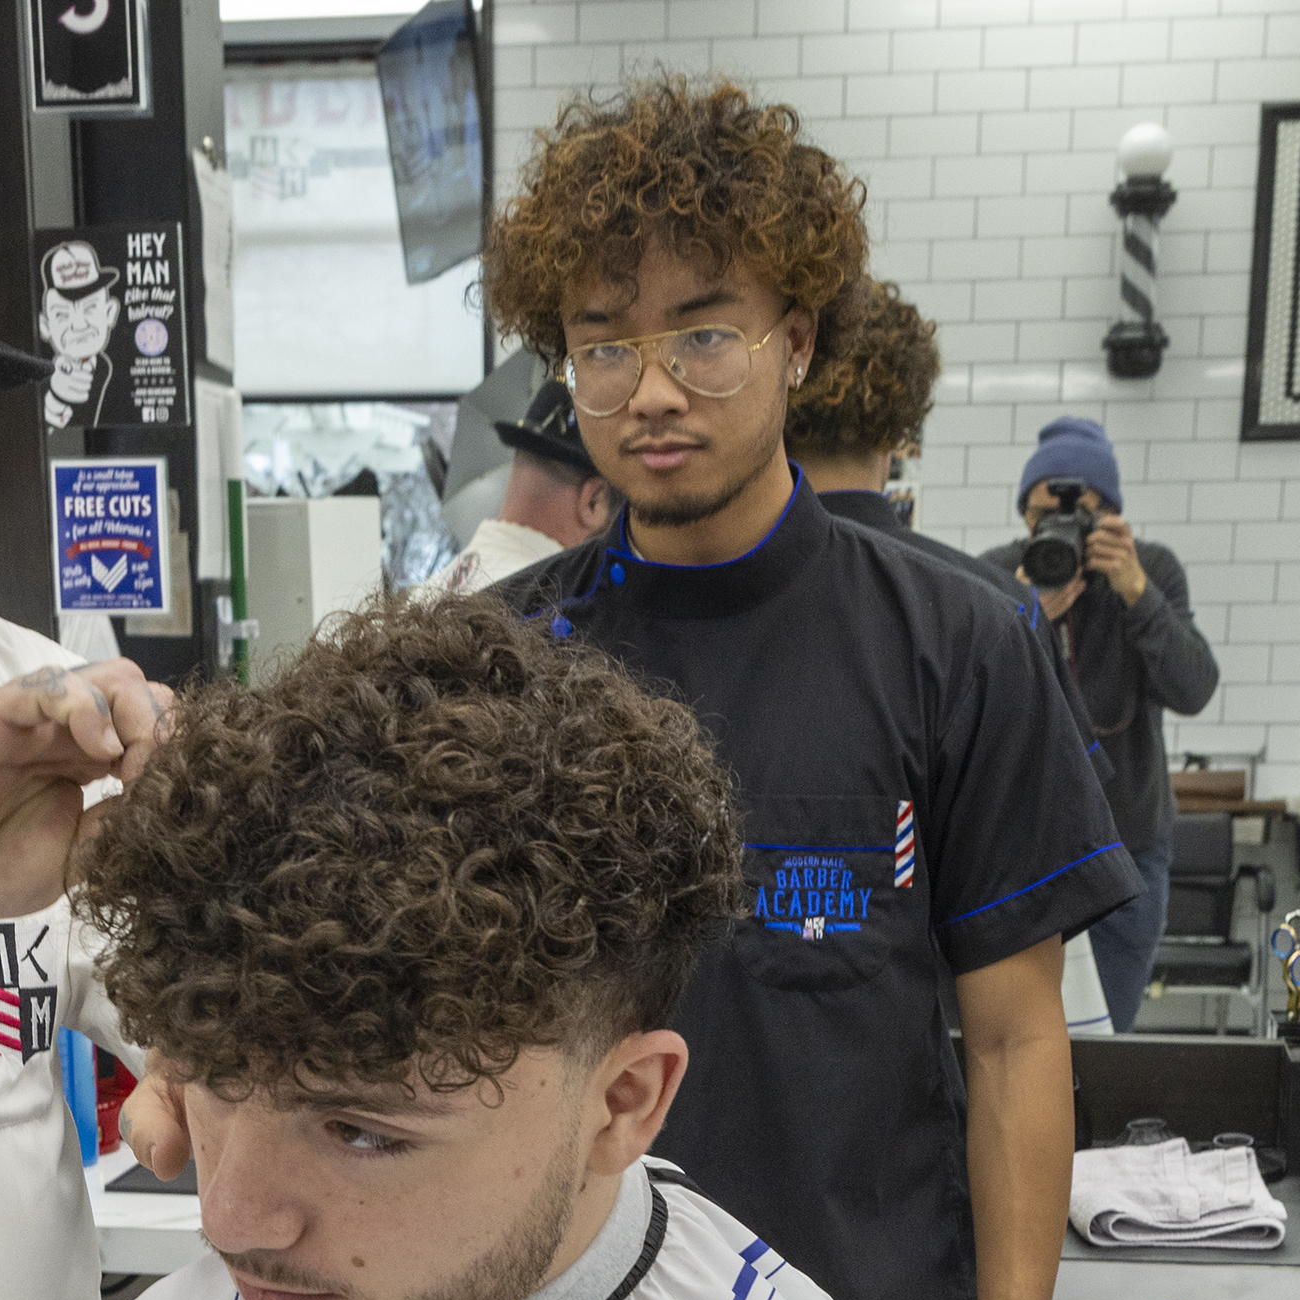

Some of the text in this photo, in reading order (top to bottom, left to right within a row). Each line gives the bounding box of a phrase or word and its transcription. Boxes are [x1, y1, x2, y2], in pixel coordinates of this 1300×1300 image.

[127, 233, 166, 258] HEY
[126, 260, 169, 285] MAN
[151, 286, 175, 302] that
[64, 495, 152, 517] FREE CUTS
[72, 523, 88, 541] for
[89, 520, 103, 535] all
[776, 868, 852, 889] BARBER
[755, 886, 873, 918] ACADEMY
